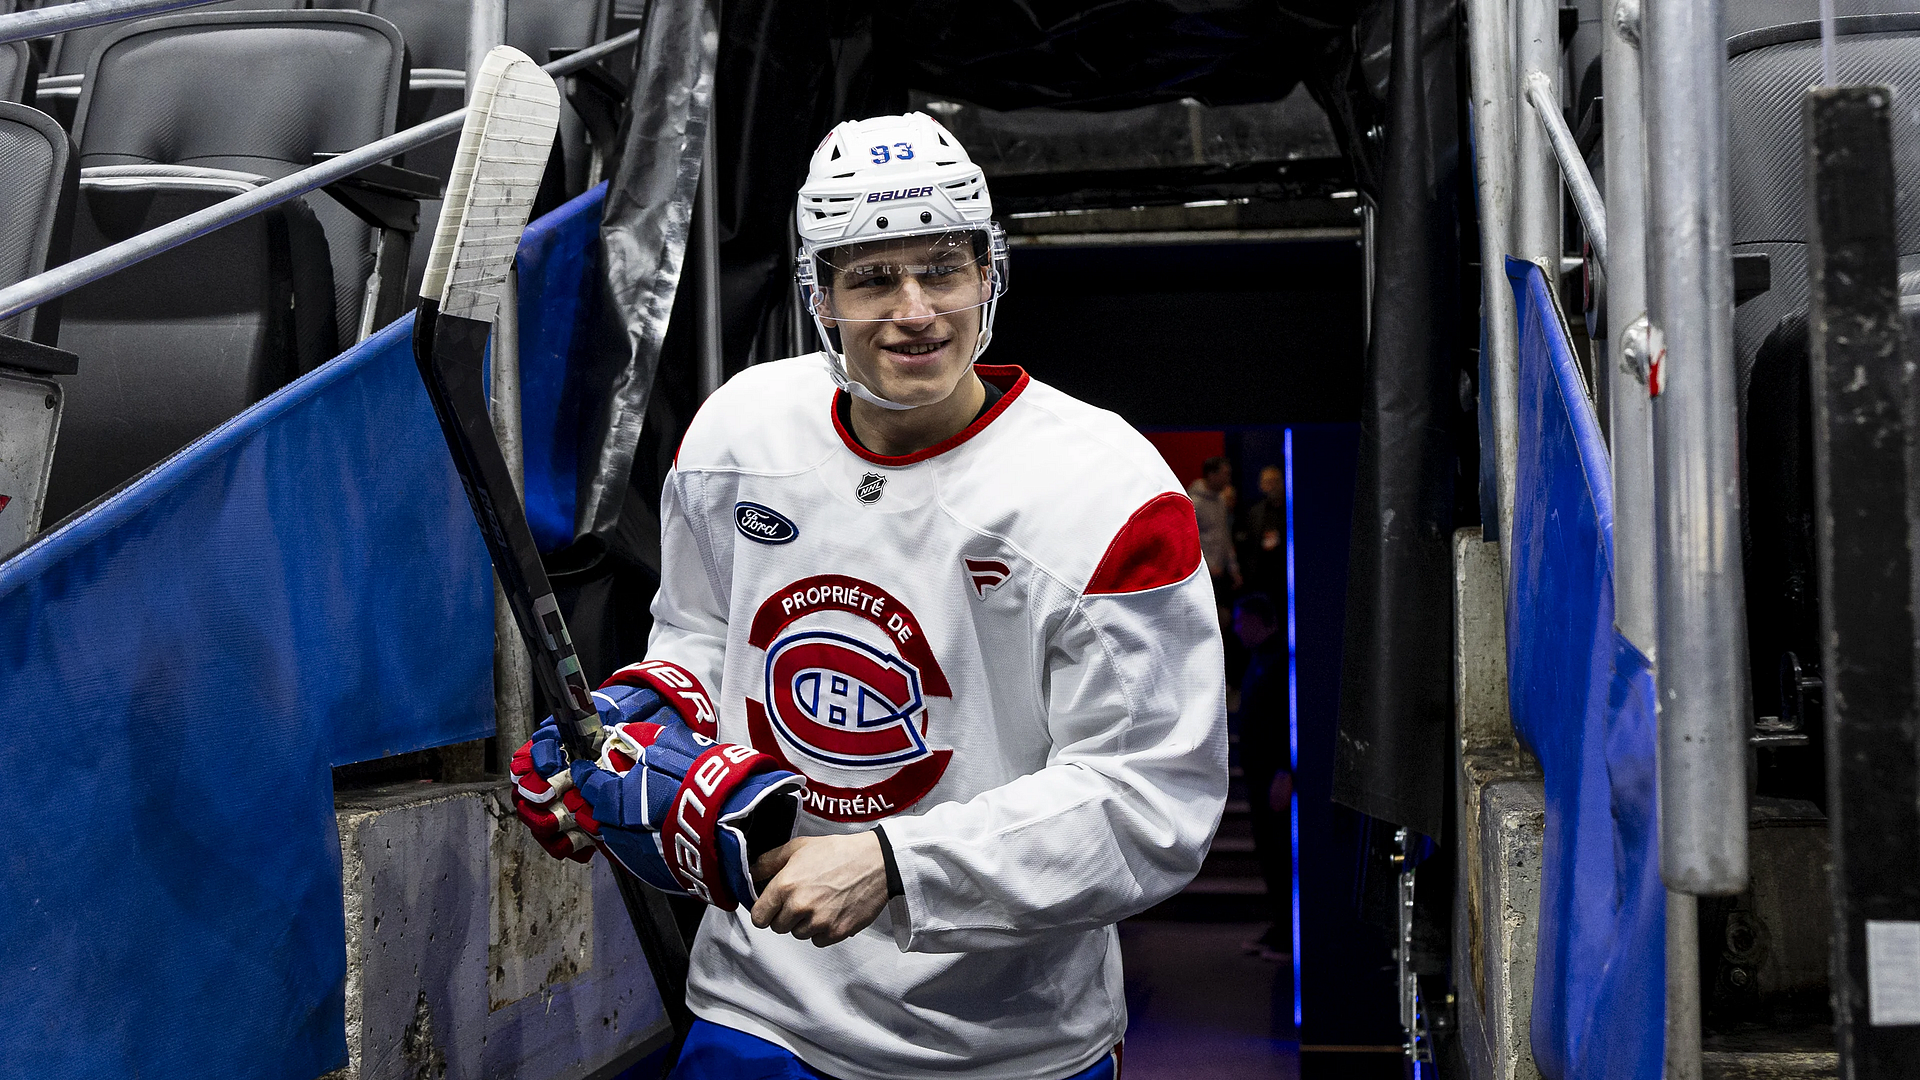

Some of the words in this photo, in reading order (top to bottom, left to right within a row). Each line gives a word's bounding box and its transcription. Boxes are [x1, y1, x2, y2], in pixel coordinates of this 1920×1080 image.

[870, 142, 915, 165] 93
[866, 186, 934, 203] BAUER
[860, 482, 882, 496] NHL
[741, 509, 779, 536] Ford
[781, 586, 886, 617] PROPRIÉTÉ
[887, 612, 913, 644] DE
[800, 785, 895, 815] ONTRÉAL
